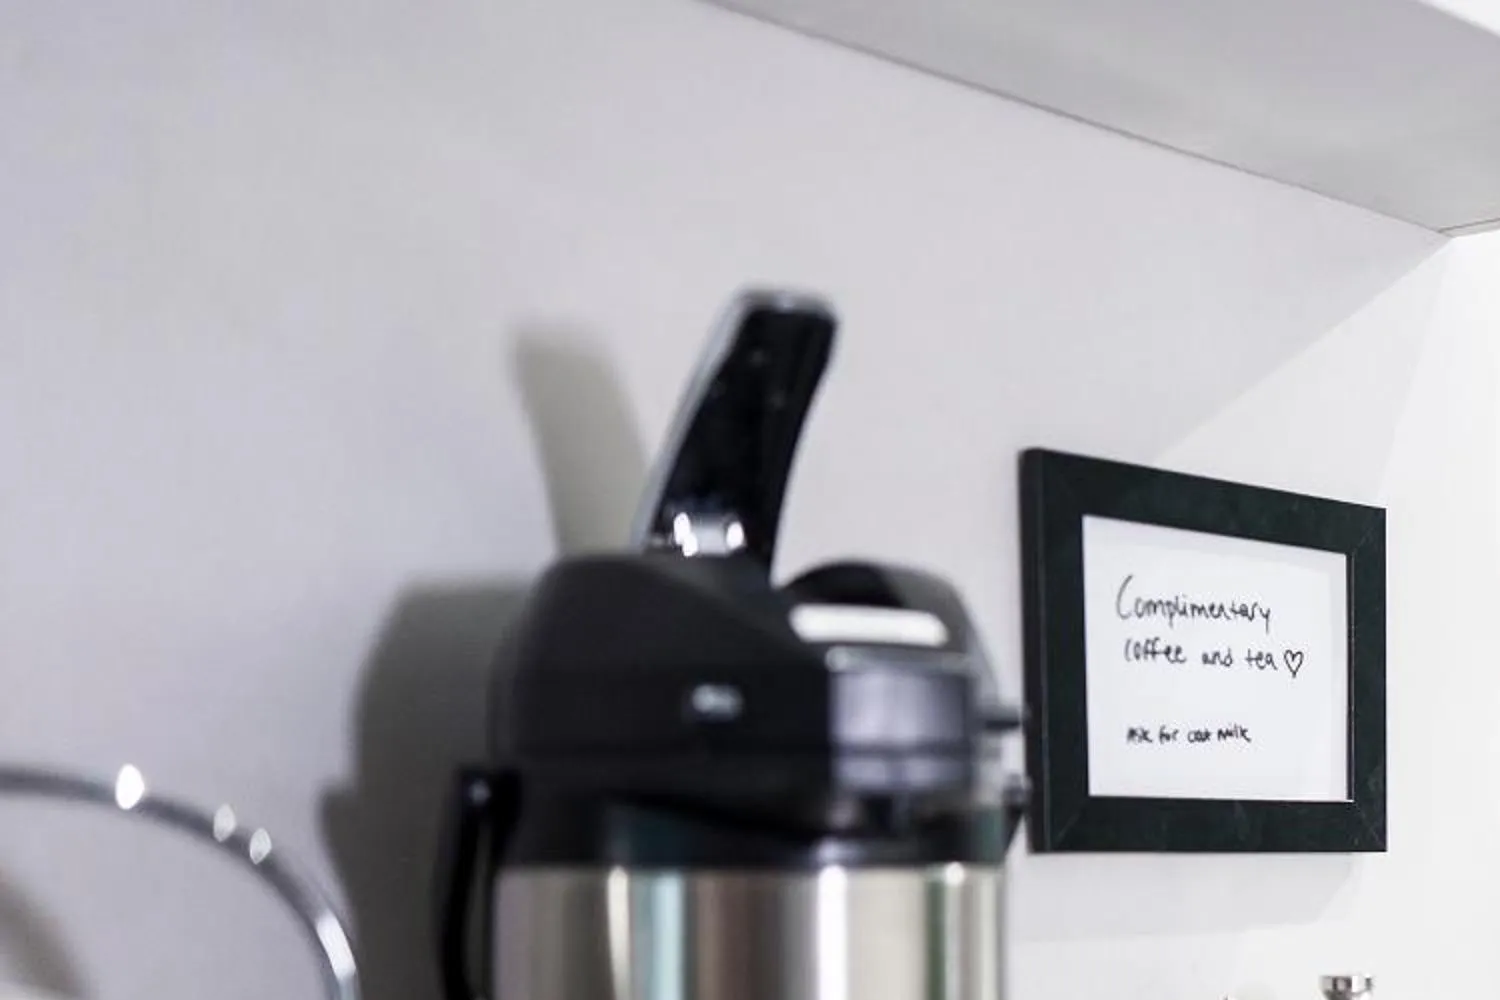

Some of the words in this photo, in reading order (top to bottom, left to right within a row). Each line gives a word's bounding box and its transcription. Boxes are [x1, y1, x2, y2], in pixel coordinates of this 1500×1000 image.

[1116, 574, 1272, 634] Complimentary
[1201, 648, 1234, 667] and
[1245, 648, 1278, 670] tea
